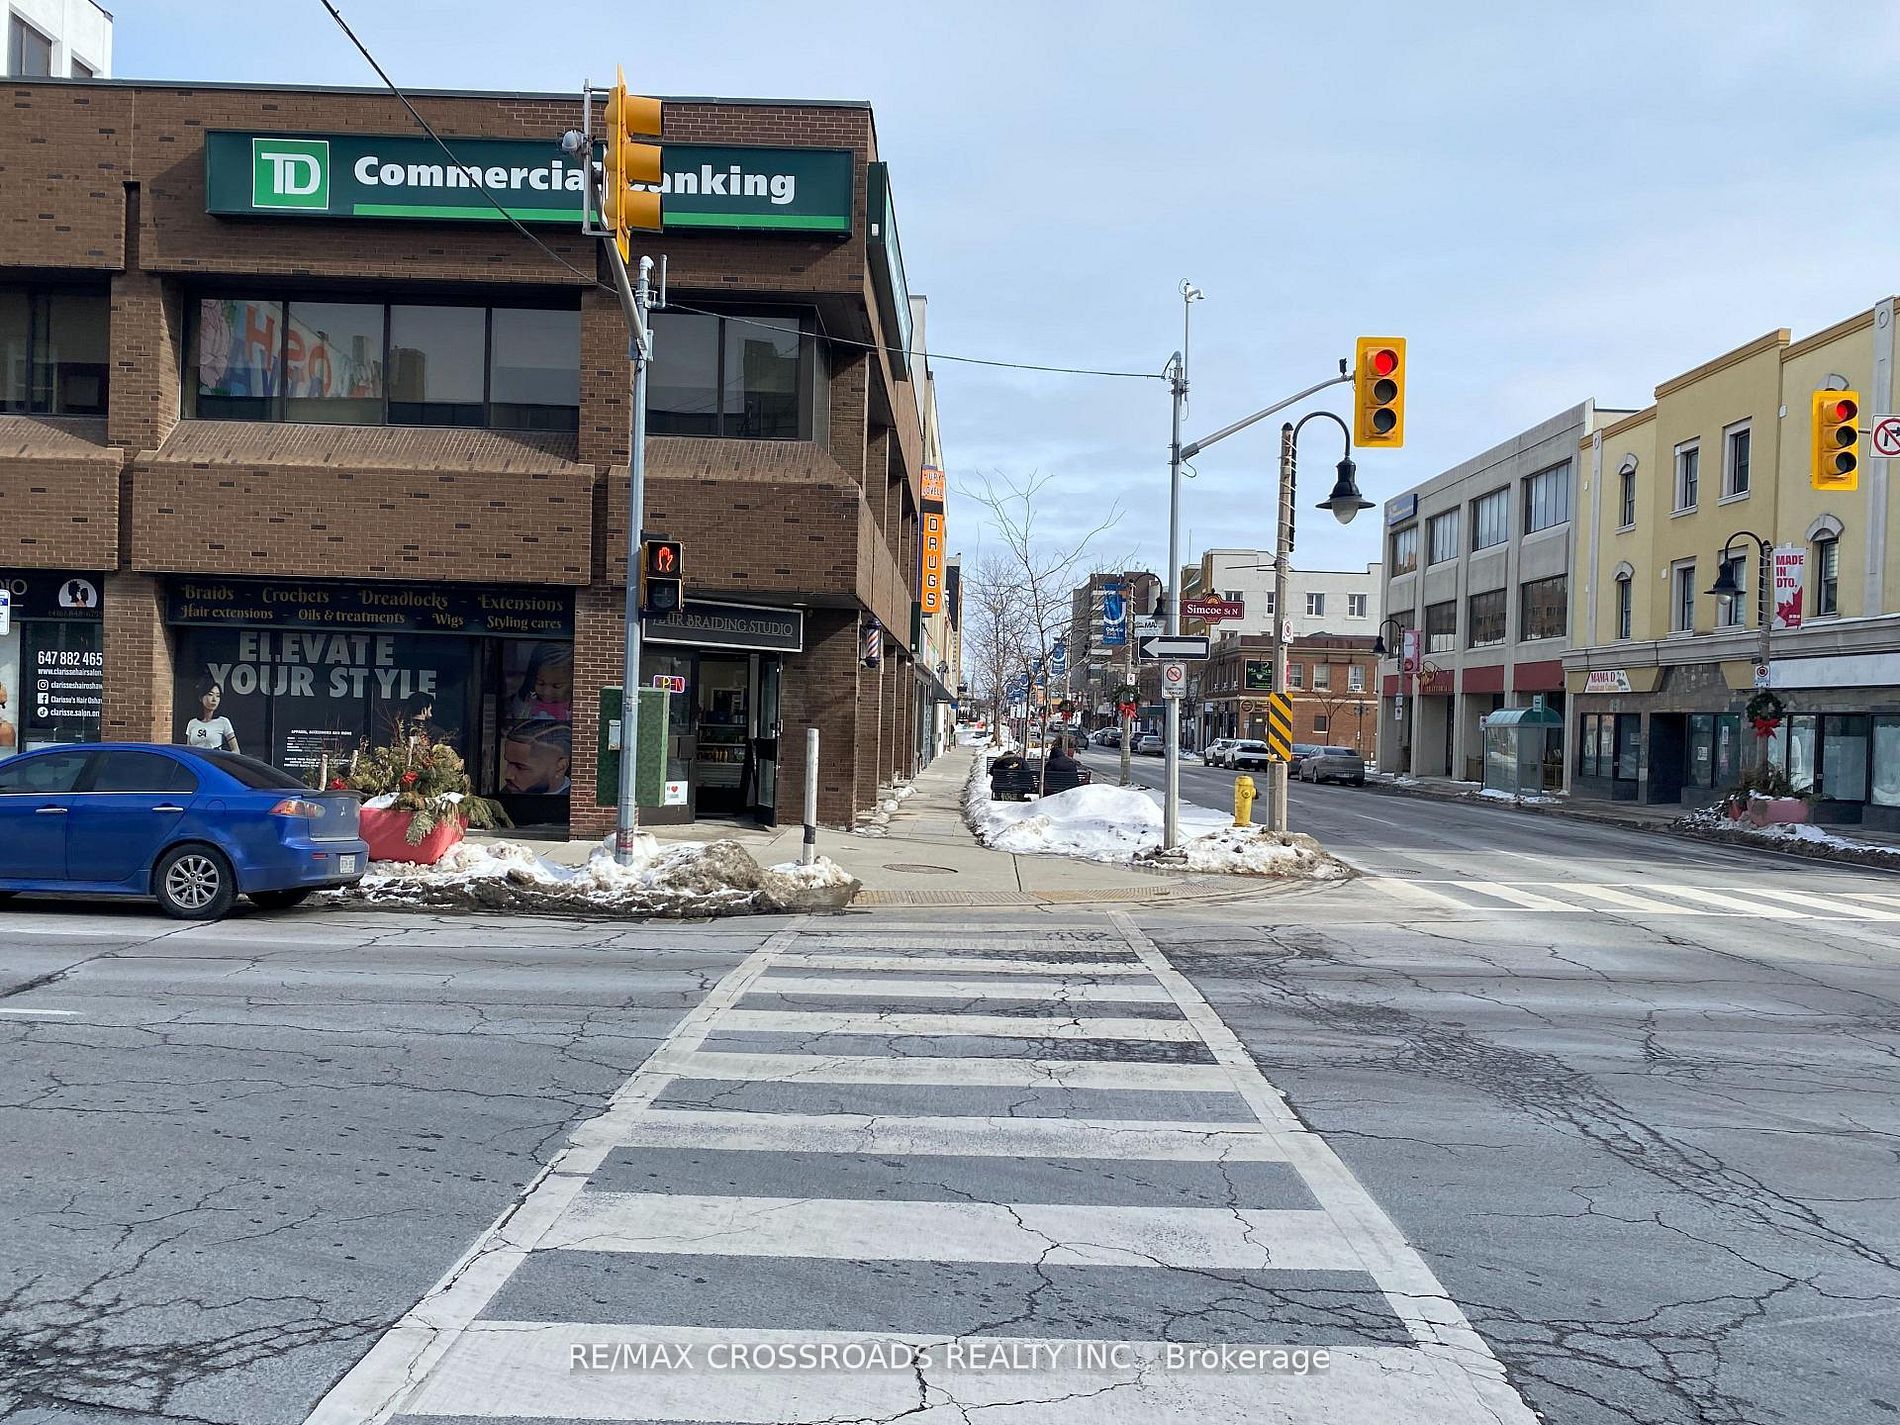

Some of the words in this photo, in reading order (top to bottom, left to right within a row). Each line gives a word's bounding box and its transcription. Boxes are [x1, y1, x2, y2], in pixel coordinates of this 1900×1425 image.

[261, 152, 322, 195] TD
[354, 156, 602, 191] Commercia
[629, 164, 796, 205] anking
[927, 516, 939, 607] DRUGS
[1775, 555, 1804, 565] MADE
[1776, 567, 1787, 576] IN
[1776, 577, 1798, 587] DTO.
[182, 584, 235, 600] Braids
[262, 586, 330, 604] Crochets
[358, 589, 449, 610] Dreadlocks
[478, 594, 564, 612] Extensions
[181, 603, 210, 618] Hair
[212, 606, 274, 619] extensions
[298, 608, 321, 621] Oils
[324, 610, 335, 621] &
[336, 610, 406, 624] treatments
[432, 612, 464, 628] Wigs
[486, 615, 528, 631] Styling
[531, 618, 562, 629] cares
[1187, 604, 1222, 615] Simcoe
[686, 614, 748, 631] BRAIDING
[749, 620, 794, 636] STUDIO
[38, 650, 58, 665] 647
[60, 651, 80, 666] 882
[239, 631, 394, 666] ELEVATE
[206, 662, 315, 698] YOUR
[329, 667, 438, 700] STYLE
[197, 729, 207, 738] SA
